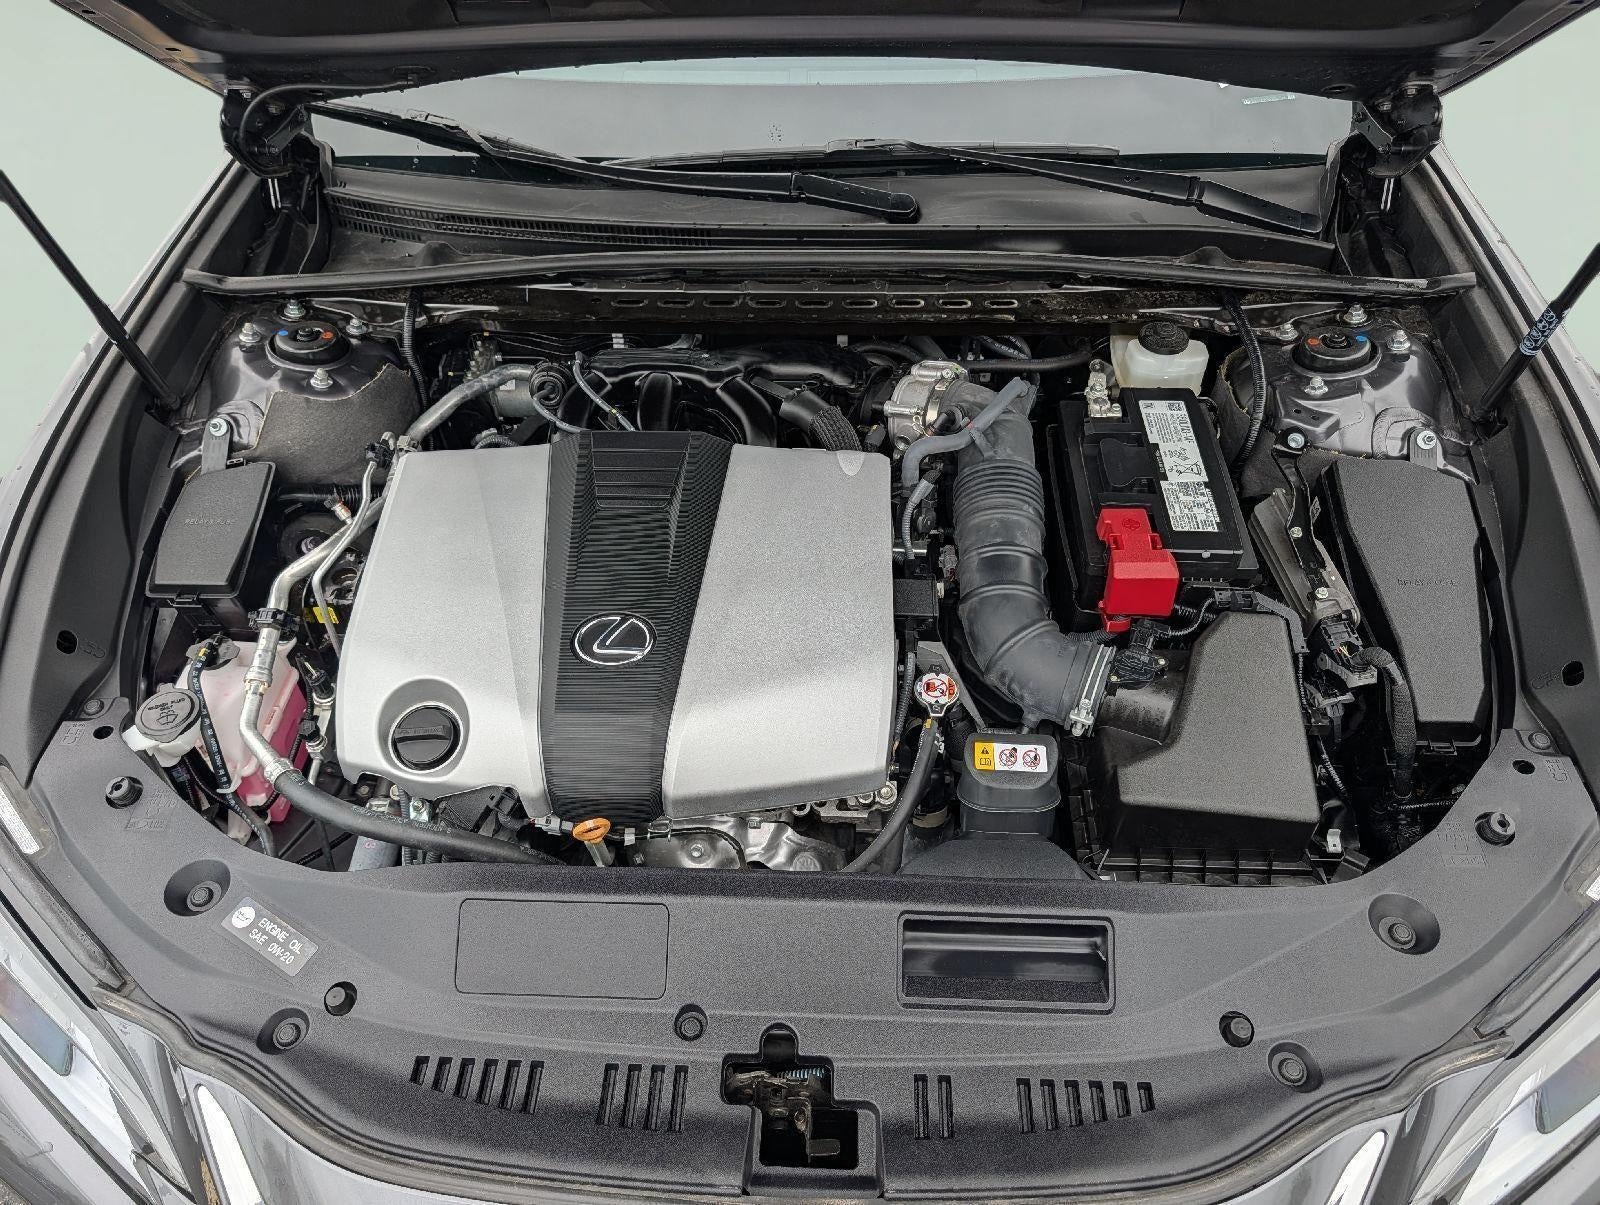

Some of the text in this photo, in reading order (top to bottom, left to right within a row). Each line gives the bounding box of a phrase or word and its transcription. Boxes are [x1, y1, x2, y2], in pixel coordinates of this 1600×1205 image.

[249, 928, 295, 965] SAE 0W-20
[258, 917, 303, 955] ENGINE OIL
